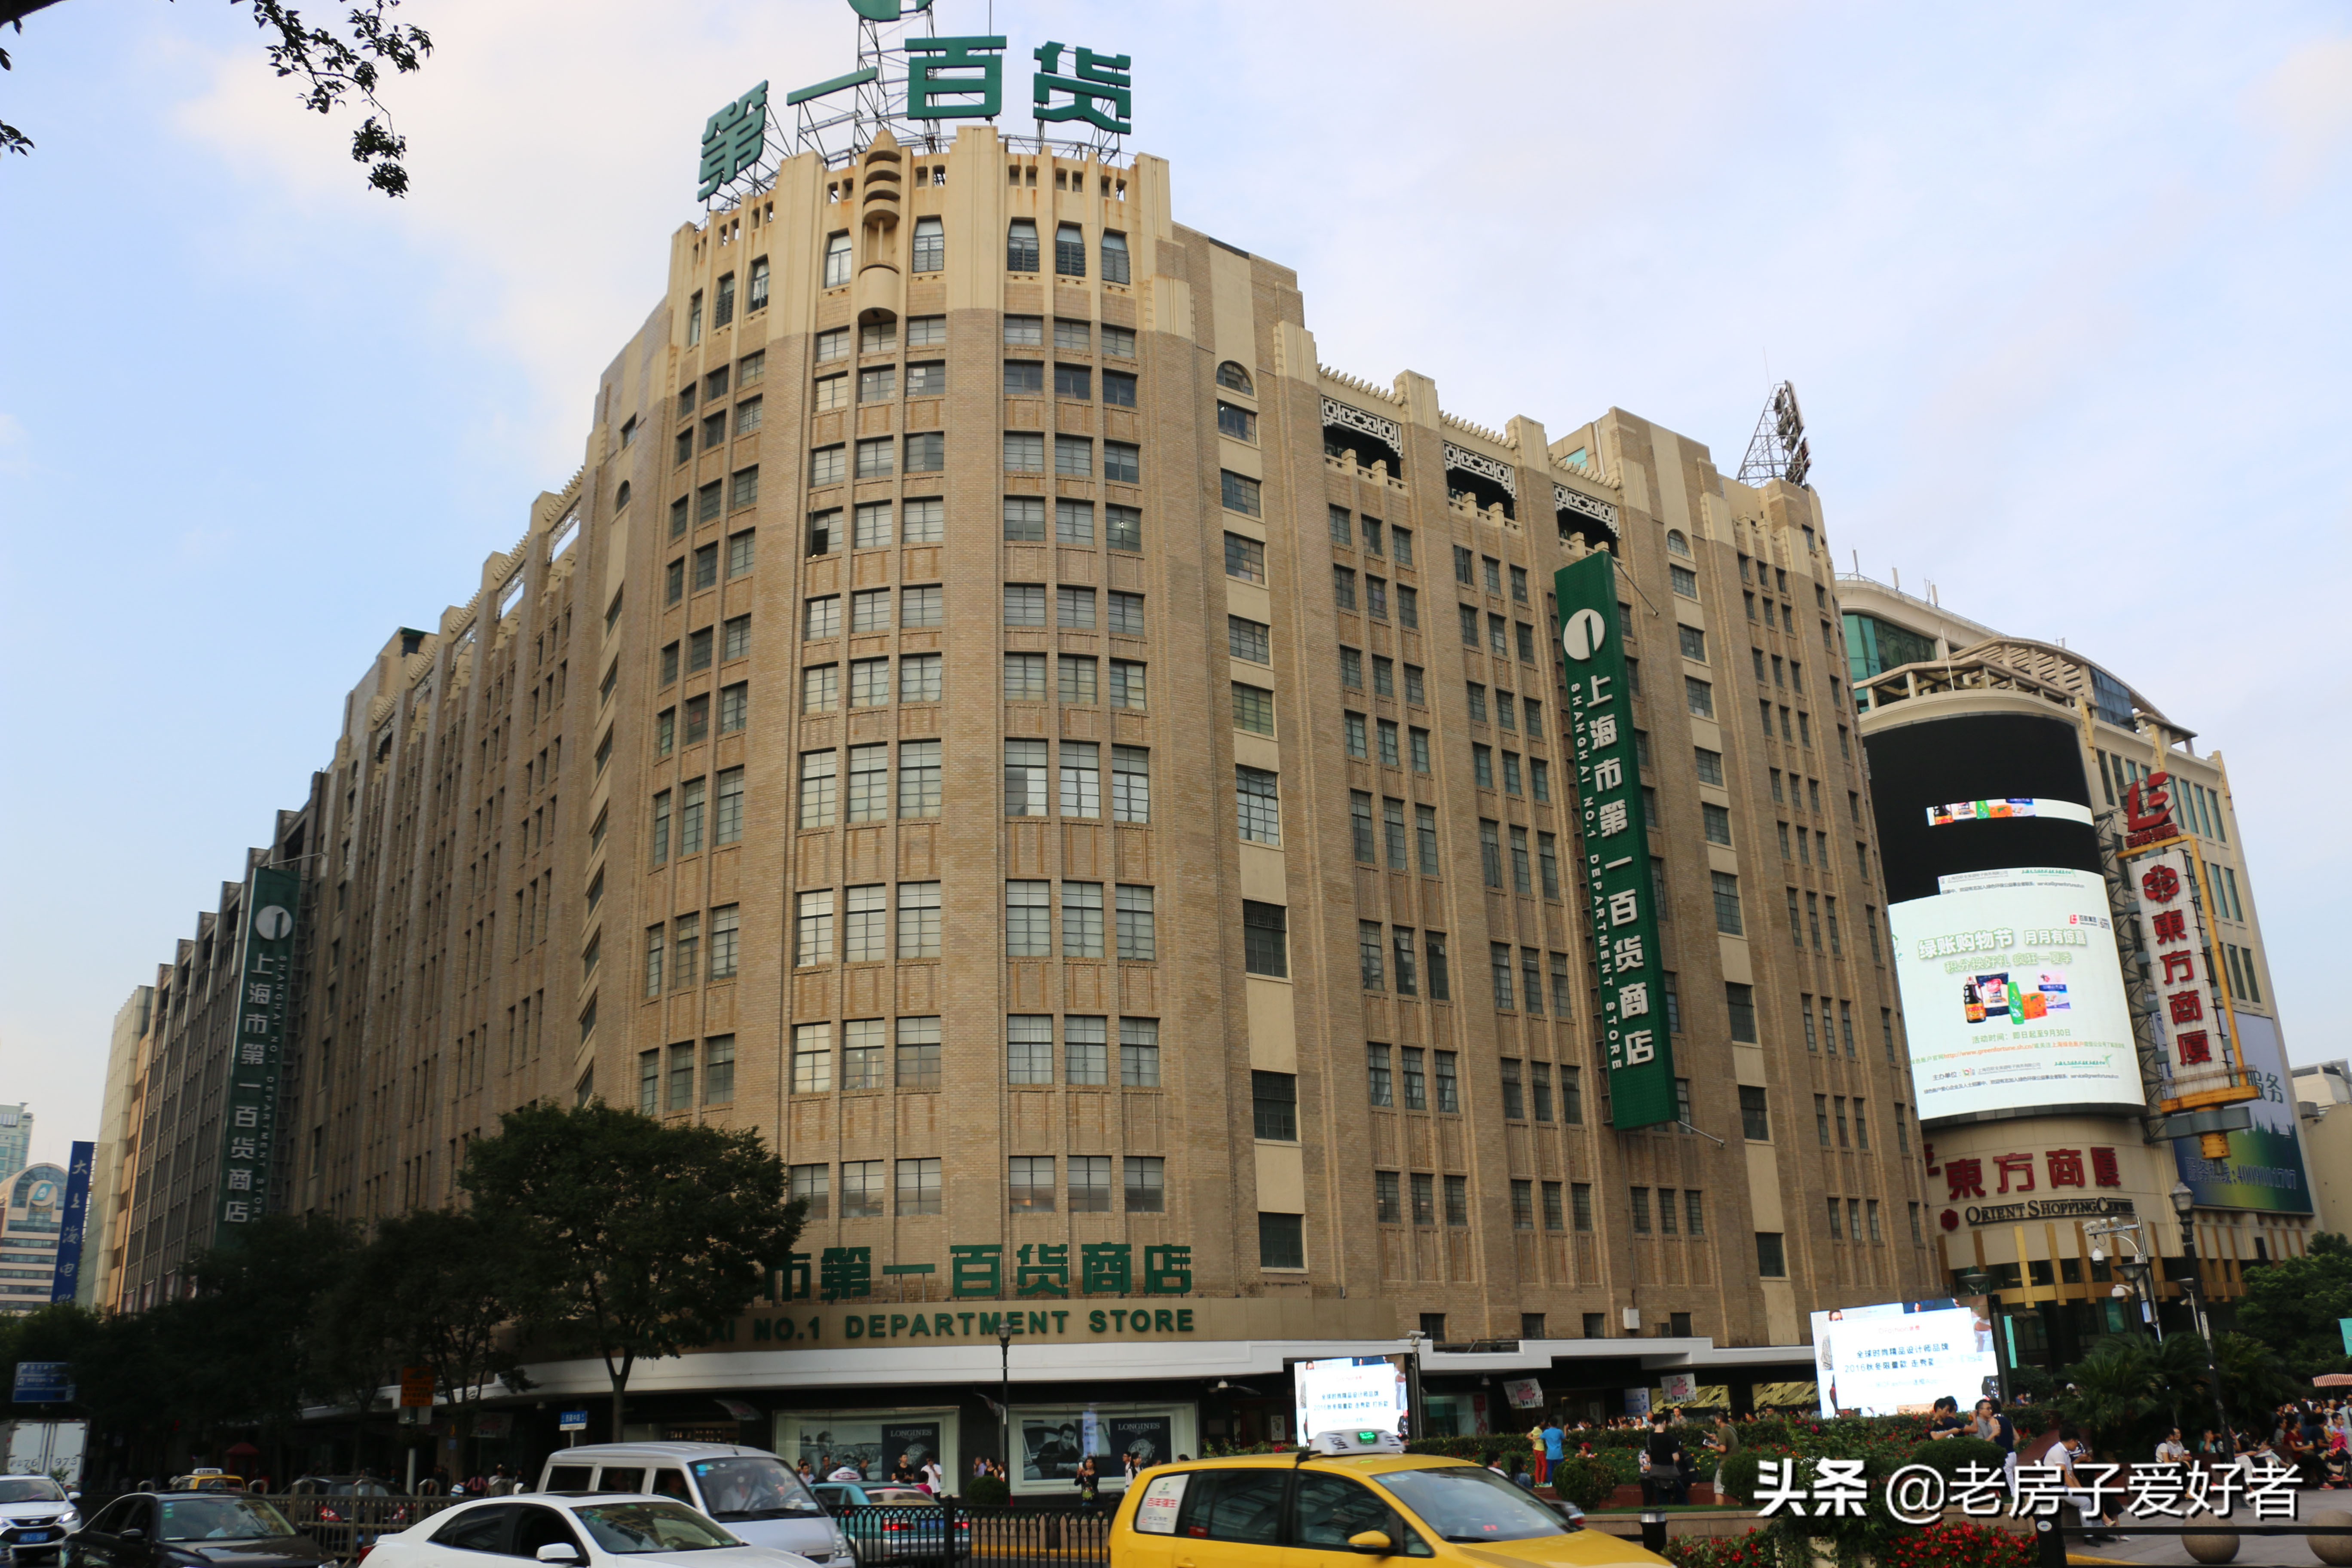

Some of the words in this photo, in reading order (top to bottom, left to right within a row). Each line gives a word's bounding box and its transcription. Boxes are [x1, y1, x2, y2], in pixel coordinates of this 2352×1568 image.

[697, 36, 1131, 202] 第一百货
[1571, 683, 1591, 783] SHANGHAI
[1583, 796, 1597, 837] NO.1
[1590, 854, 1613, 986] DEPARTMENT
[1606, 1001, 1622, 1069] STORE
[1587, 675, 1654, 1066] 上海市第一百货商店
[1918, 928, 2013, 959] 绿账购物节
[2024, 929, 2087, 946] 月月有惊喜
[1944, 954, 2010, 974] 积分换好礼
[273, 955, 287, 1025] SHANGHAI
[2152, 909, 2212, 1066] 東方商厦
[268, 1036, 279, 1063] NO.1
[224, 953, 274, 1223] 上海市第一百货商店
[258, 1076, 275, 1167] DEPARTMENT
[1945, 1147, 2121, 1200] 東方商厦
[1965, 1206, 2025, 1223] ORIENT
[2028, 1200, 2097, 1217] SHOPPING
[764, 1242, 1193, 1301] 市第一百货商店
[754, 1317, 820, 1340] NO.1
[845, 1311, 1069, 1339] DEPARTMENT
[1089, 1309, 1194, 1333] STORE
